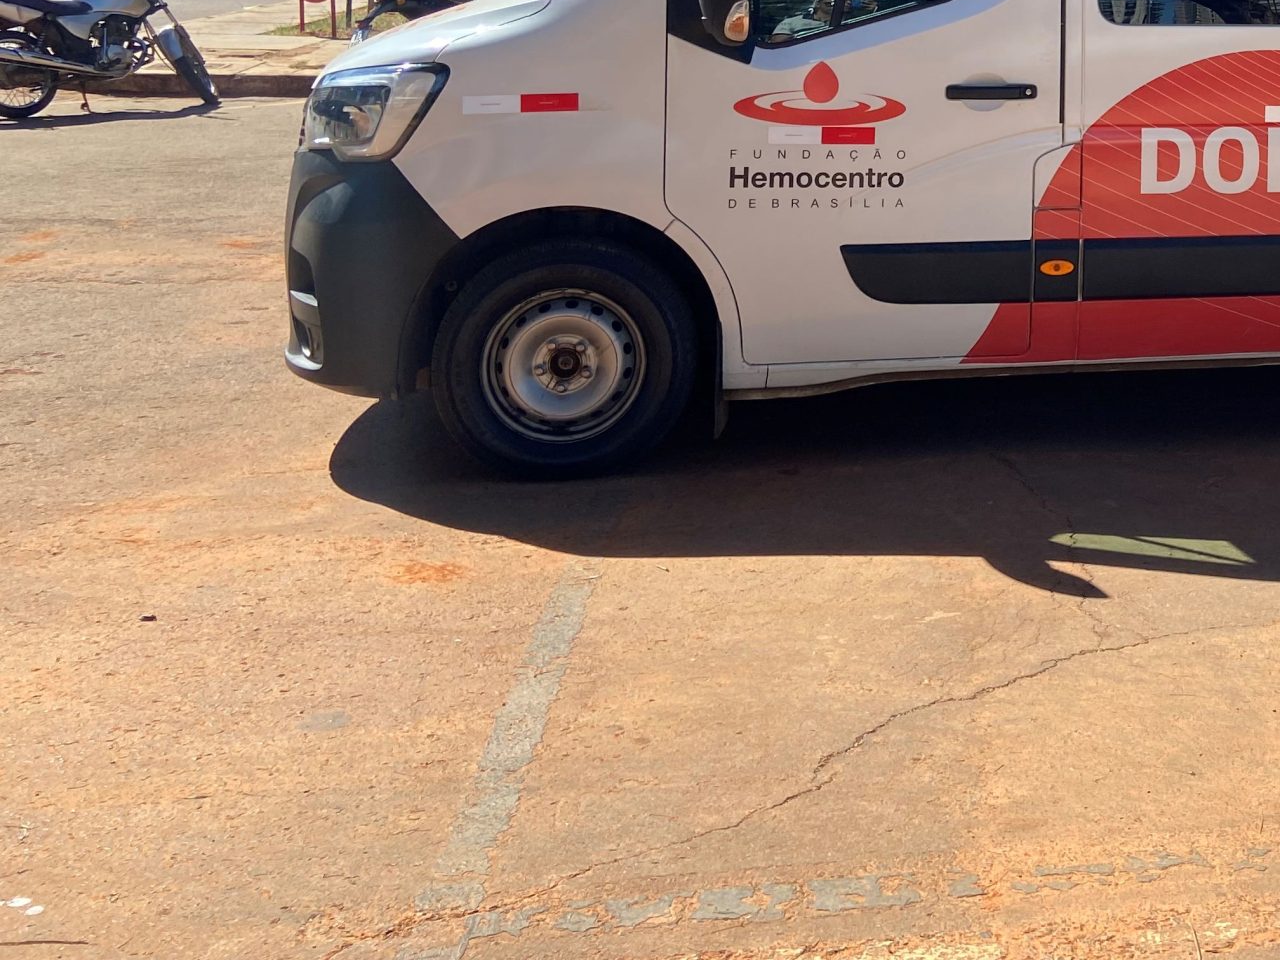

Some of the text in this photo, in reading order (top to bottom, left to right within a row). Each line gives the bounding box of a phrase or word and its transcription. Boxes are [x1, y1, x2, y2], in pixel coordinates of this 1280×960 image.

[729, 149, 906, 162] FUNDAÇÃO
[729, 166, 905, 189] Hemocentro
[771, 196, 904, 209] BRASÍLIA
